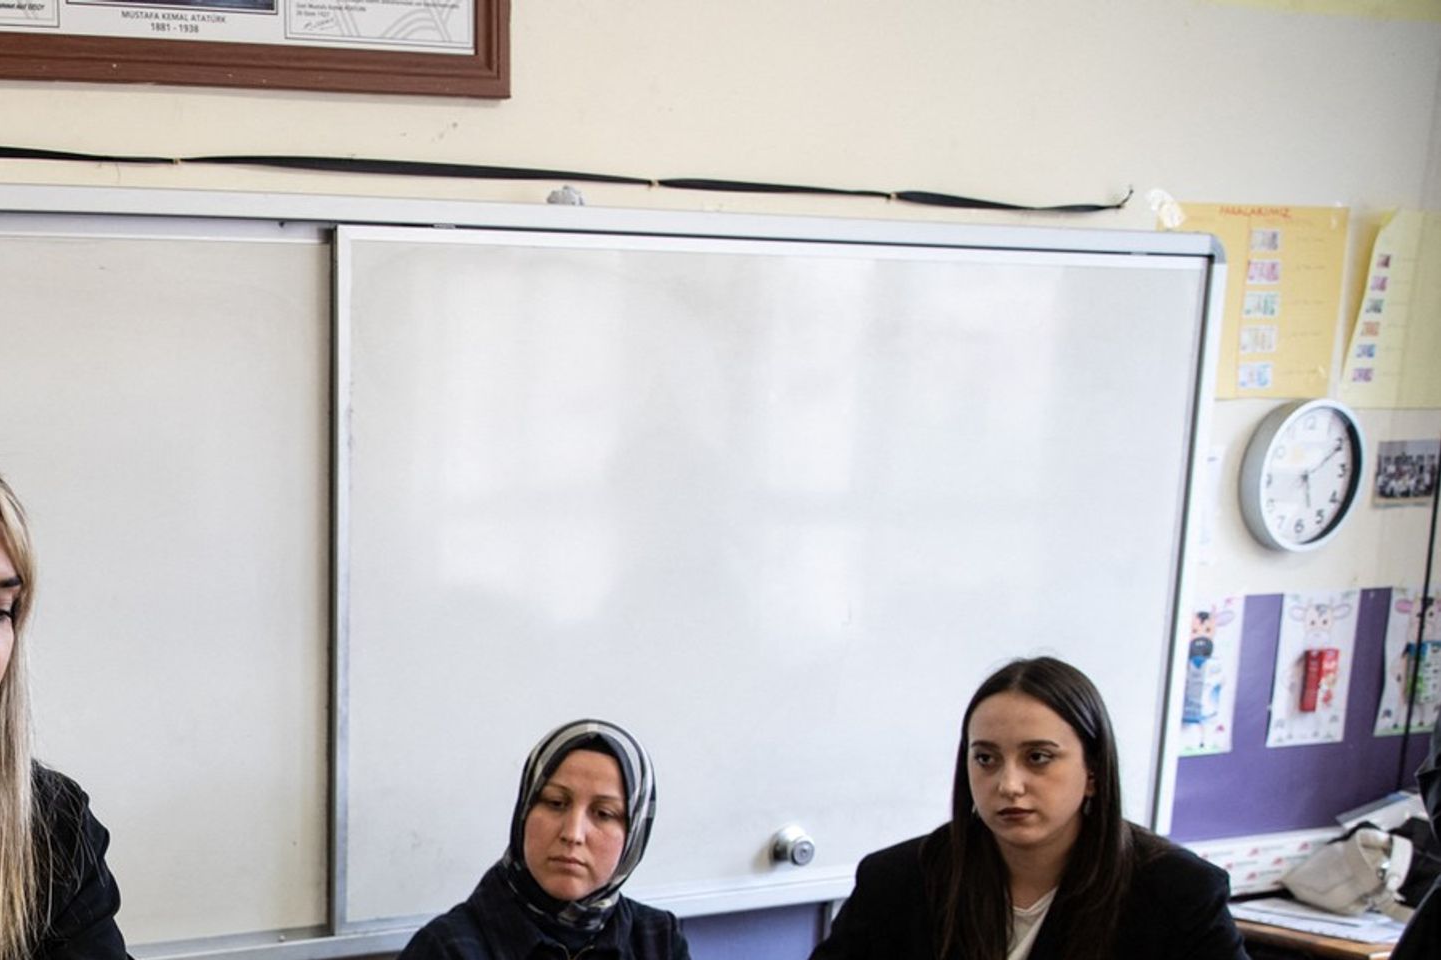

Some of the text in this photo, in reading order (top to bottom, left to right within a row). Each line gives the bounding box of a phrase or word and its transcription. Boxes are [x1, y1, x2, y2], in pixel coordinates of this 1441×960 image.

[121, 10, 226, 24] MUSTAFA KEMAL ATATÜRK
[151, 22, 171, 32] 1881
[179, 23, 199, 33] 1938
[1337, 463, 1347, 478] 3
[1328, 490, 1338, 503] 4
[1315, 508, 1325, 524] 5
[1294, 518, 1304, 534] 6
